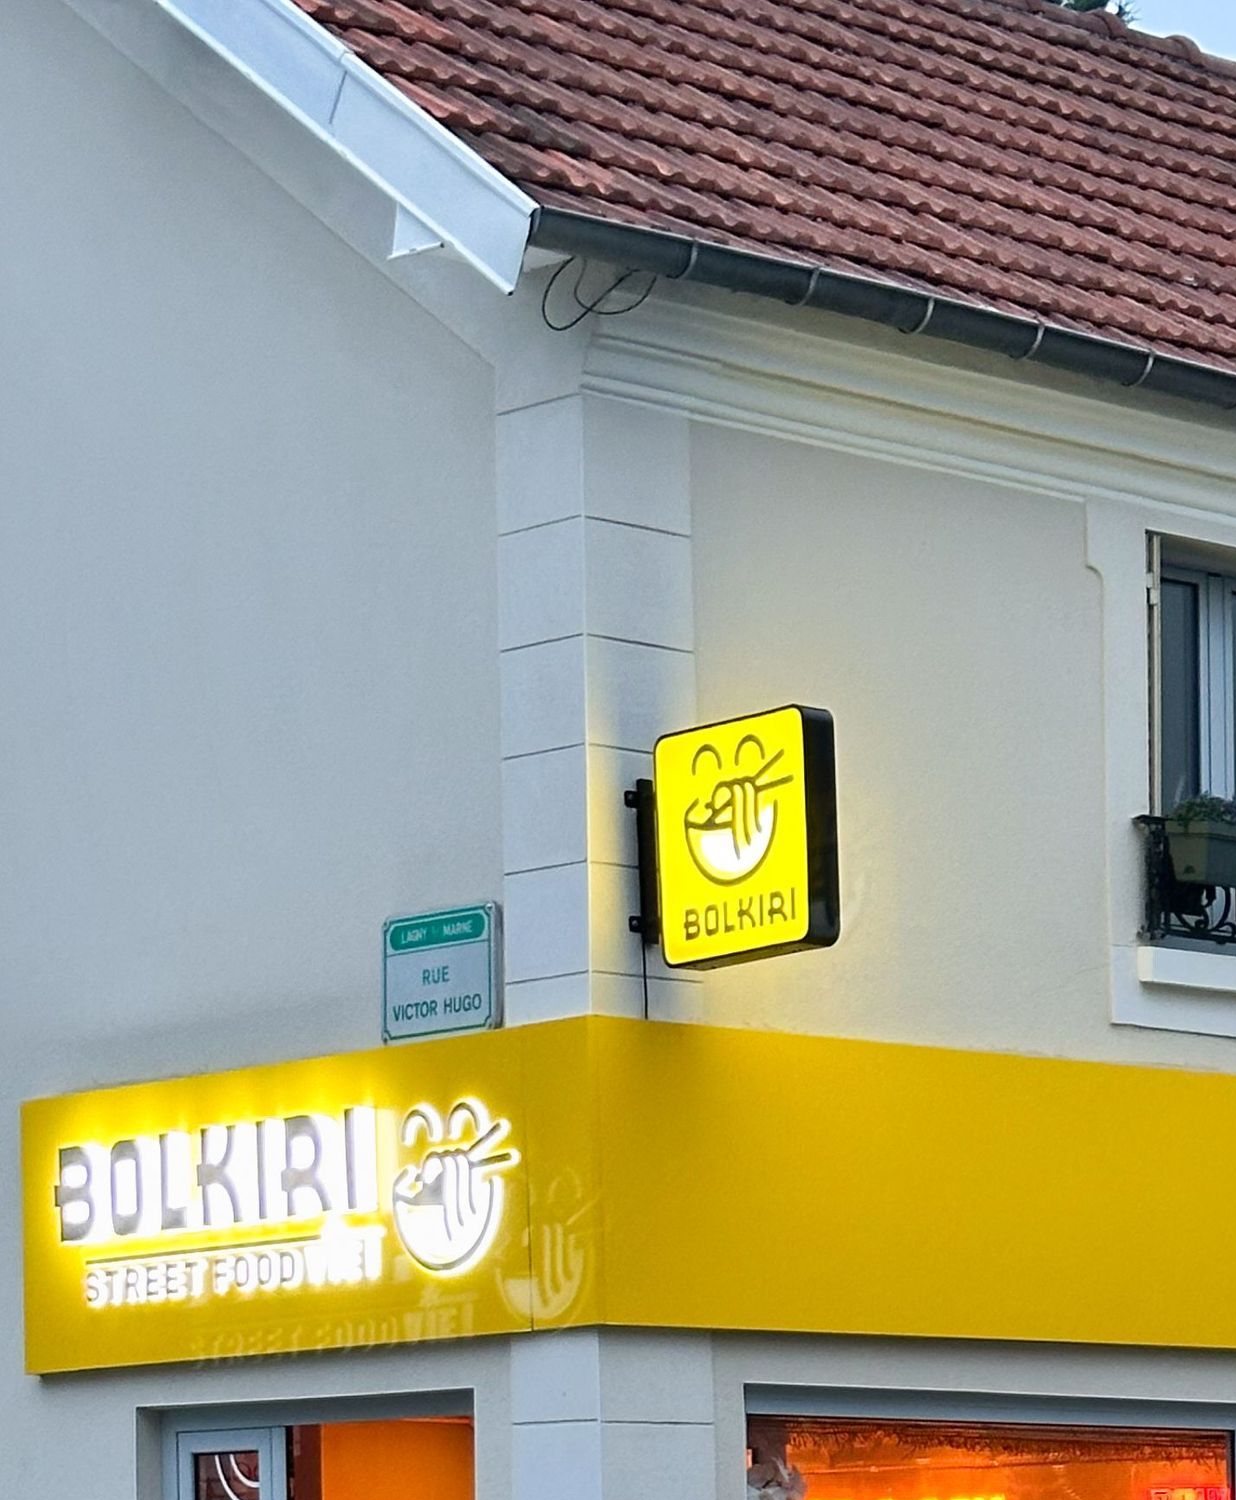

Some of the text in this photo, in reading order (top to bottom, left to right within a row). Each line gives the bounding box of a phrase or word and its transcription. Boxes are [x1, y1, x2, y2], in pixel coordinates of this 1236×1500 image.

[684, 888, 797, 941] BOLKIRI
[422, 965, 451, 986] RUE
[392, 993, 482, 1022] VICTOR HUGO
[55, 1106, 377, 1243] BOLKIRI
[85, 1263, 203, 1303] STREET
[213, 1251, 297, 1294] FOOD
